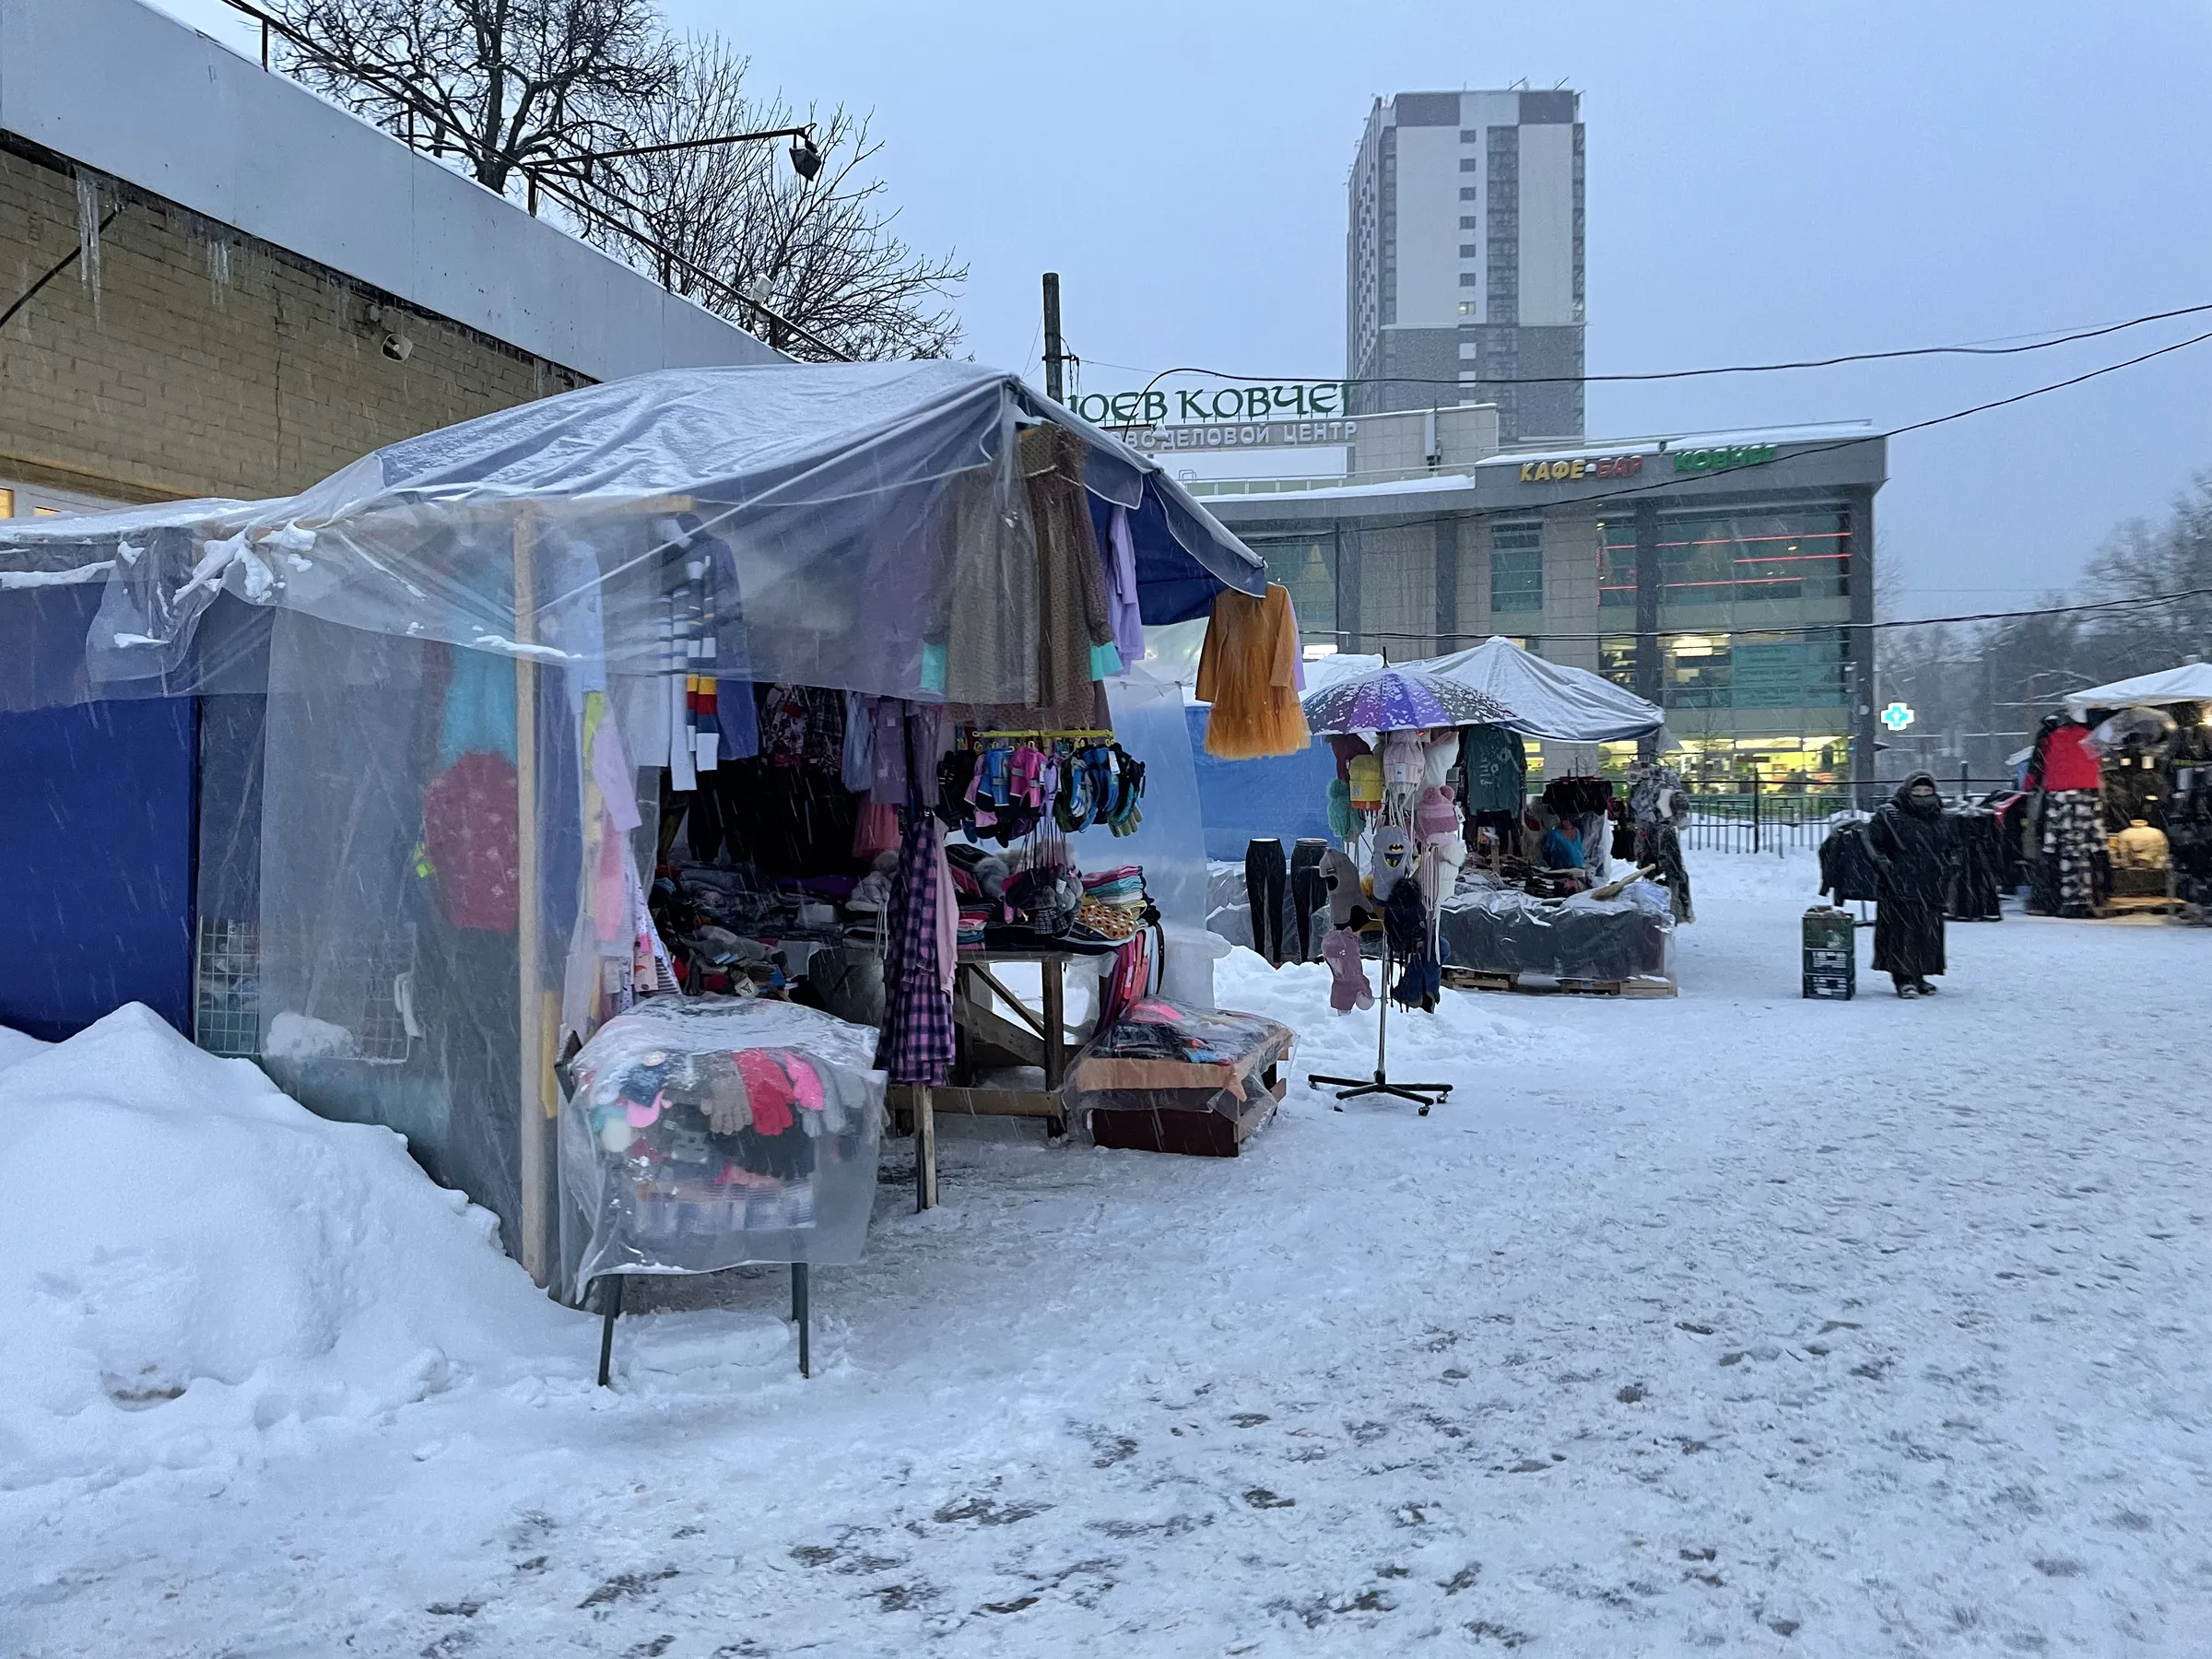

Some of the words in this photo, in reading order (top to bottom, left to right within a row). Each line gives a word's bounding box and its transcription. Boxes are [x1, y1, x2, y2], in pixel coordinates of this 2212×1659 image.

[1174, 381, 1364, 418] КОВЧЕГ
[1110, 423, 1270, 451] ВОДЕЛОВОЙ
[1283, 421, 1358, 446] ЦЕНТР
